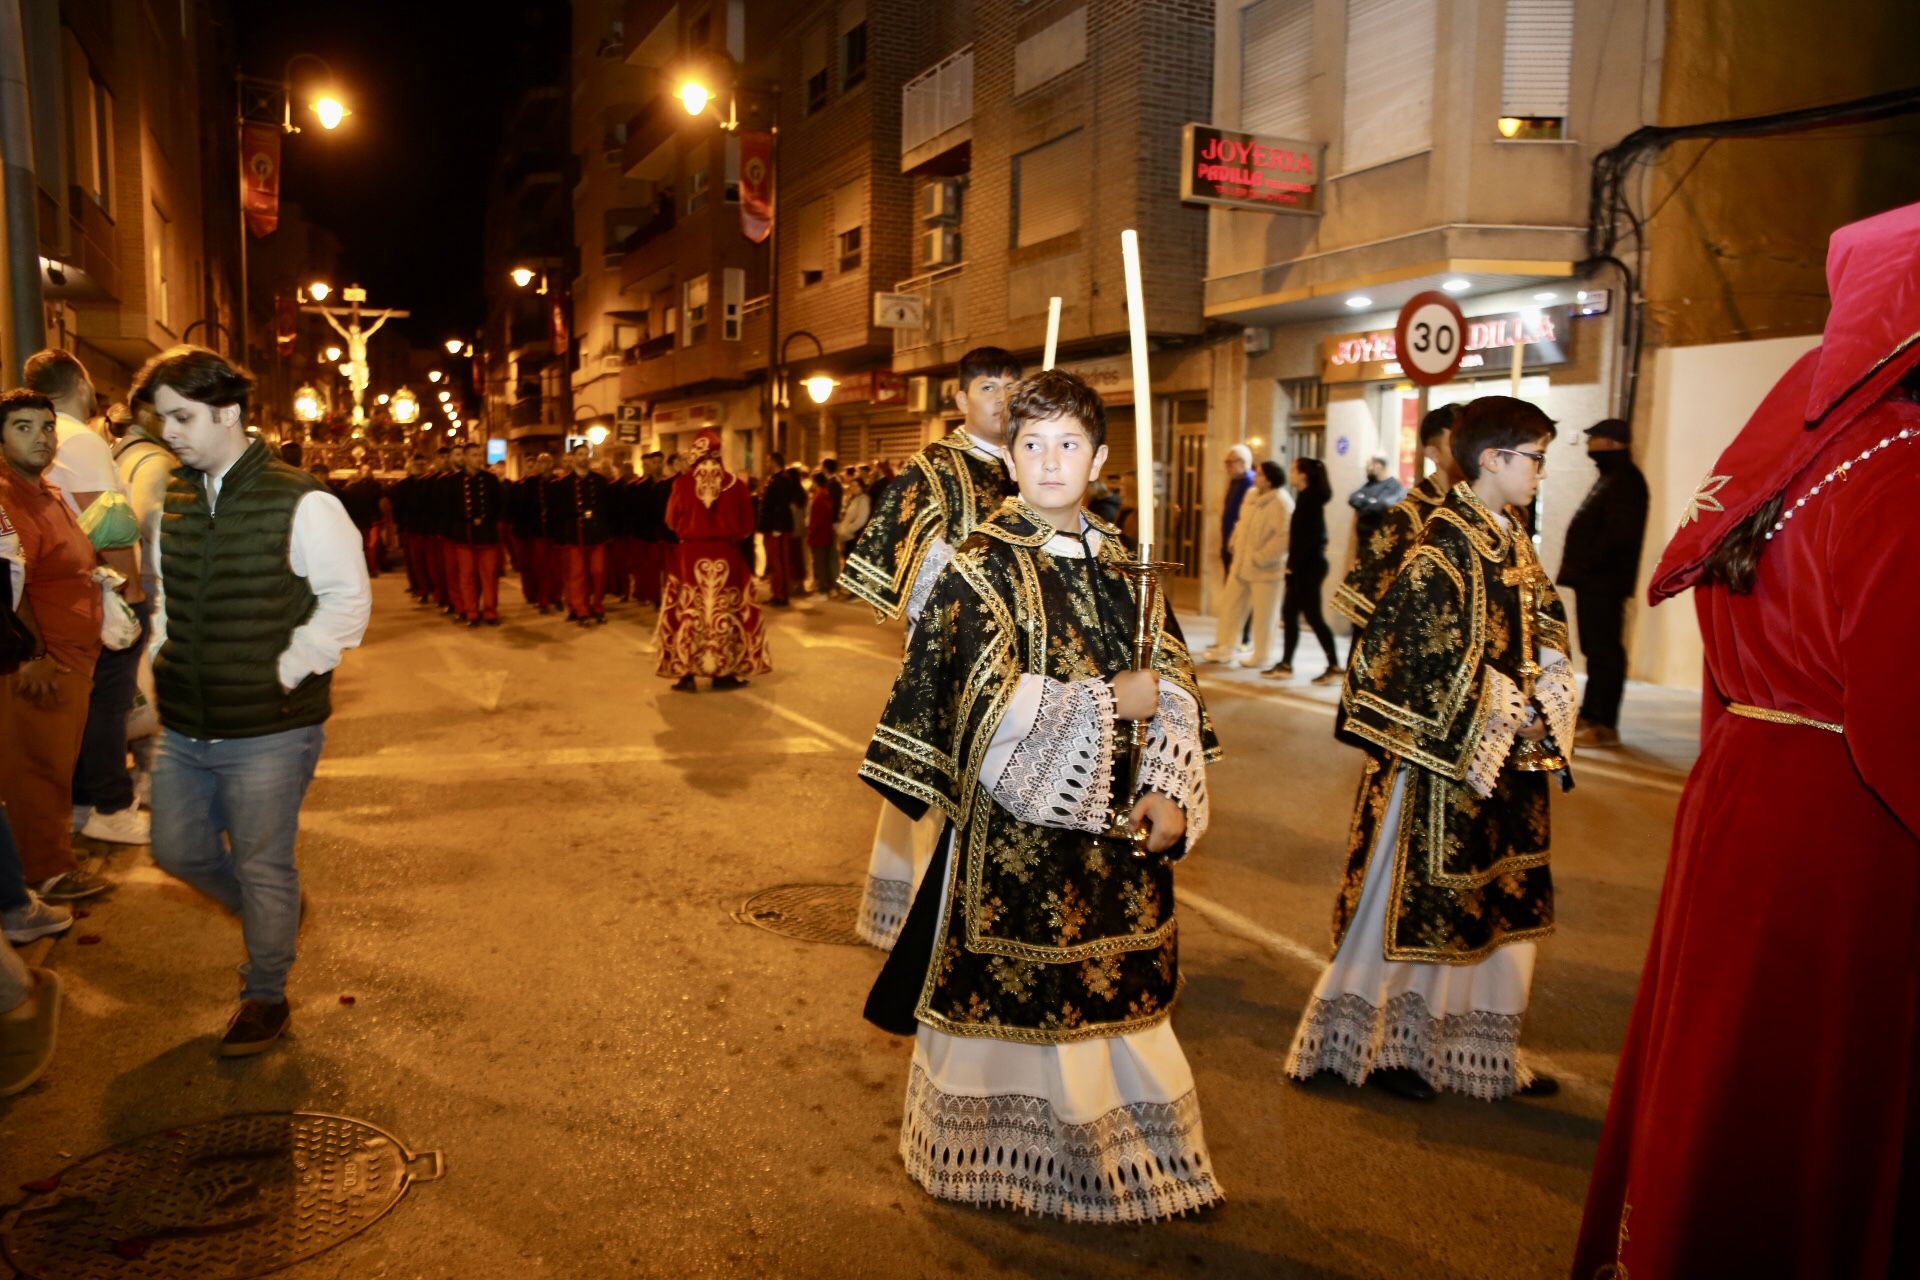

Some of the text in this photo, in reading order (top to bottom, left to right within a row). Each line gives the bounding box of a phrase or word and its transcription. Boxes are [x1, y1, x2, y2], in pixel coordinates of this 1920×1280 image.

[1201, 138, 1312, 175] JOYERIA
[1413, 322, 1455, 355] 30
[1464, 314, 1557, 351] DILLA
